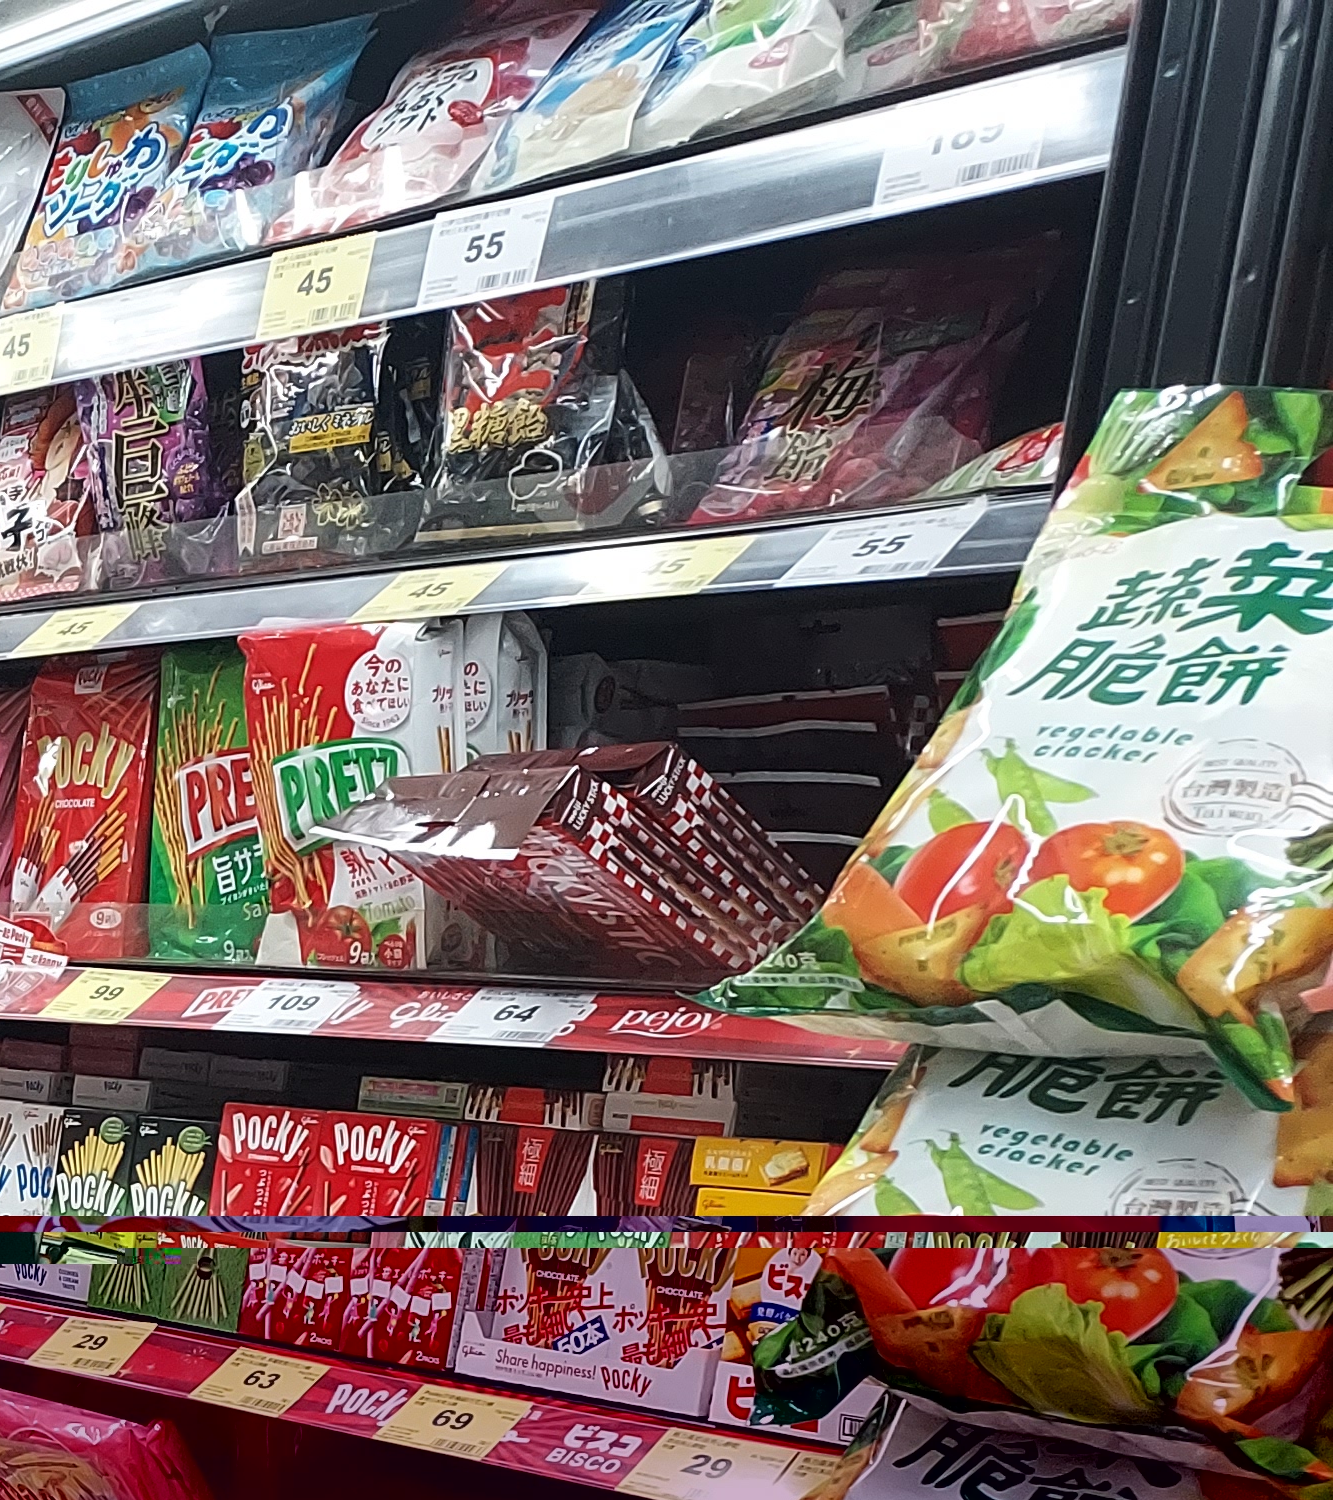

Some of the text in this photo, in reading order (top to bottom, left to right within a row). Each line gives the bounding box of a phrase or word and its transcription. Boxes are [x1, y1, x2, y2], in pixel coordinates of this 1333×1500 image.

[464, 231, 505, 261] 55
[298, 266, 332, 295] 45
[3, 334, 30, 359] 45
[850, 533, 915, 557] 55
[407, 580, 449, 600] 45
[1077, 541, 1333, 637] 蔬菜
[59, 621, 92, 638] 45
[364, 654, 402, 677] 今の
[1009, 635, 1293, 706] 脆餅
[351, 678, 410, 698] あなたに
[1036, 721, 1196, 748] vegetable
[1034, 741, 1167, 766] cracker
[279, 746, 399, 841] PRETZ
[1180, 776, 1288, 803] 台灣製造
[87, 982, 125, 1003] 99
[267, 993, 320, 1013] 109
[493, 1004, 539, 1024] 64
[609, 1006, 722, 1038] pejoy
[979, 1122, 1135, 1163] vegetable
[977, 1140, 1102, 1178] cracker
[535, 1270, 580, 1283] CHOCOLATE
[656, 1284, 704, 1299] CHOCOLATE
[74, 1333, 109, 1352] 29
[555, 1316, 607, 1353] 50本
[495, 1348, 543, 1370] Share
[545, 1353, 596, 1380] happiness!
[242, 1368, 281, 1389] 63
[431, 1407, 476, 1430] 69
[563, 1423, 644, 1461] ビスコ
[544, 1446, 622, 1475] BISCO
[685, 1453, 733, 1479] 29
